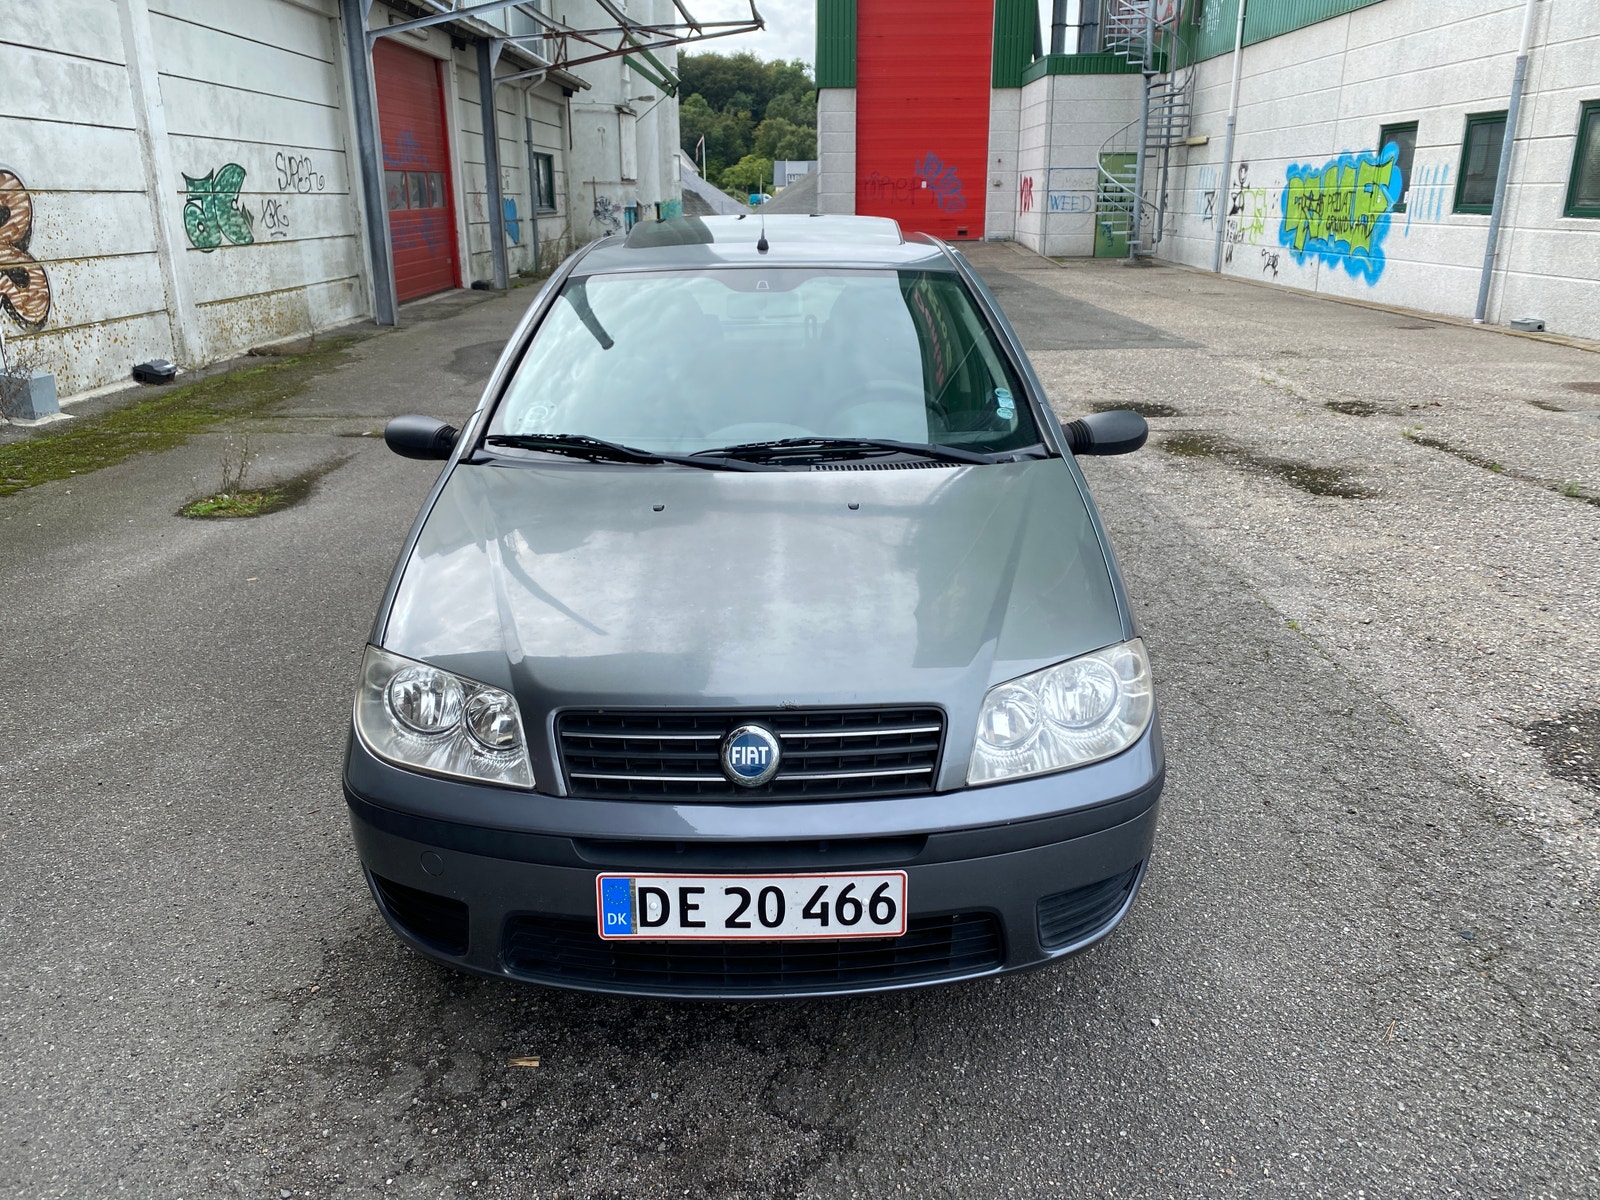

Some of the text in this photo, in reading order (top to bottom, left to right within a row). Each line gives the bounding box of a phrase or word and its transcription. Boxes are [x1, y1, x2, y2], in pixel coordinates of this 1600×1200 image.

[1050, 195, 1092, 212] WEED
[731, 746, 769, 765] FIAT
[638, 886, 706, 928] DE
[724, 885, 786, 928] 20
[802, 881, 897, 926] 466
[607, 912, 628, 926] DK
